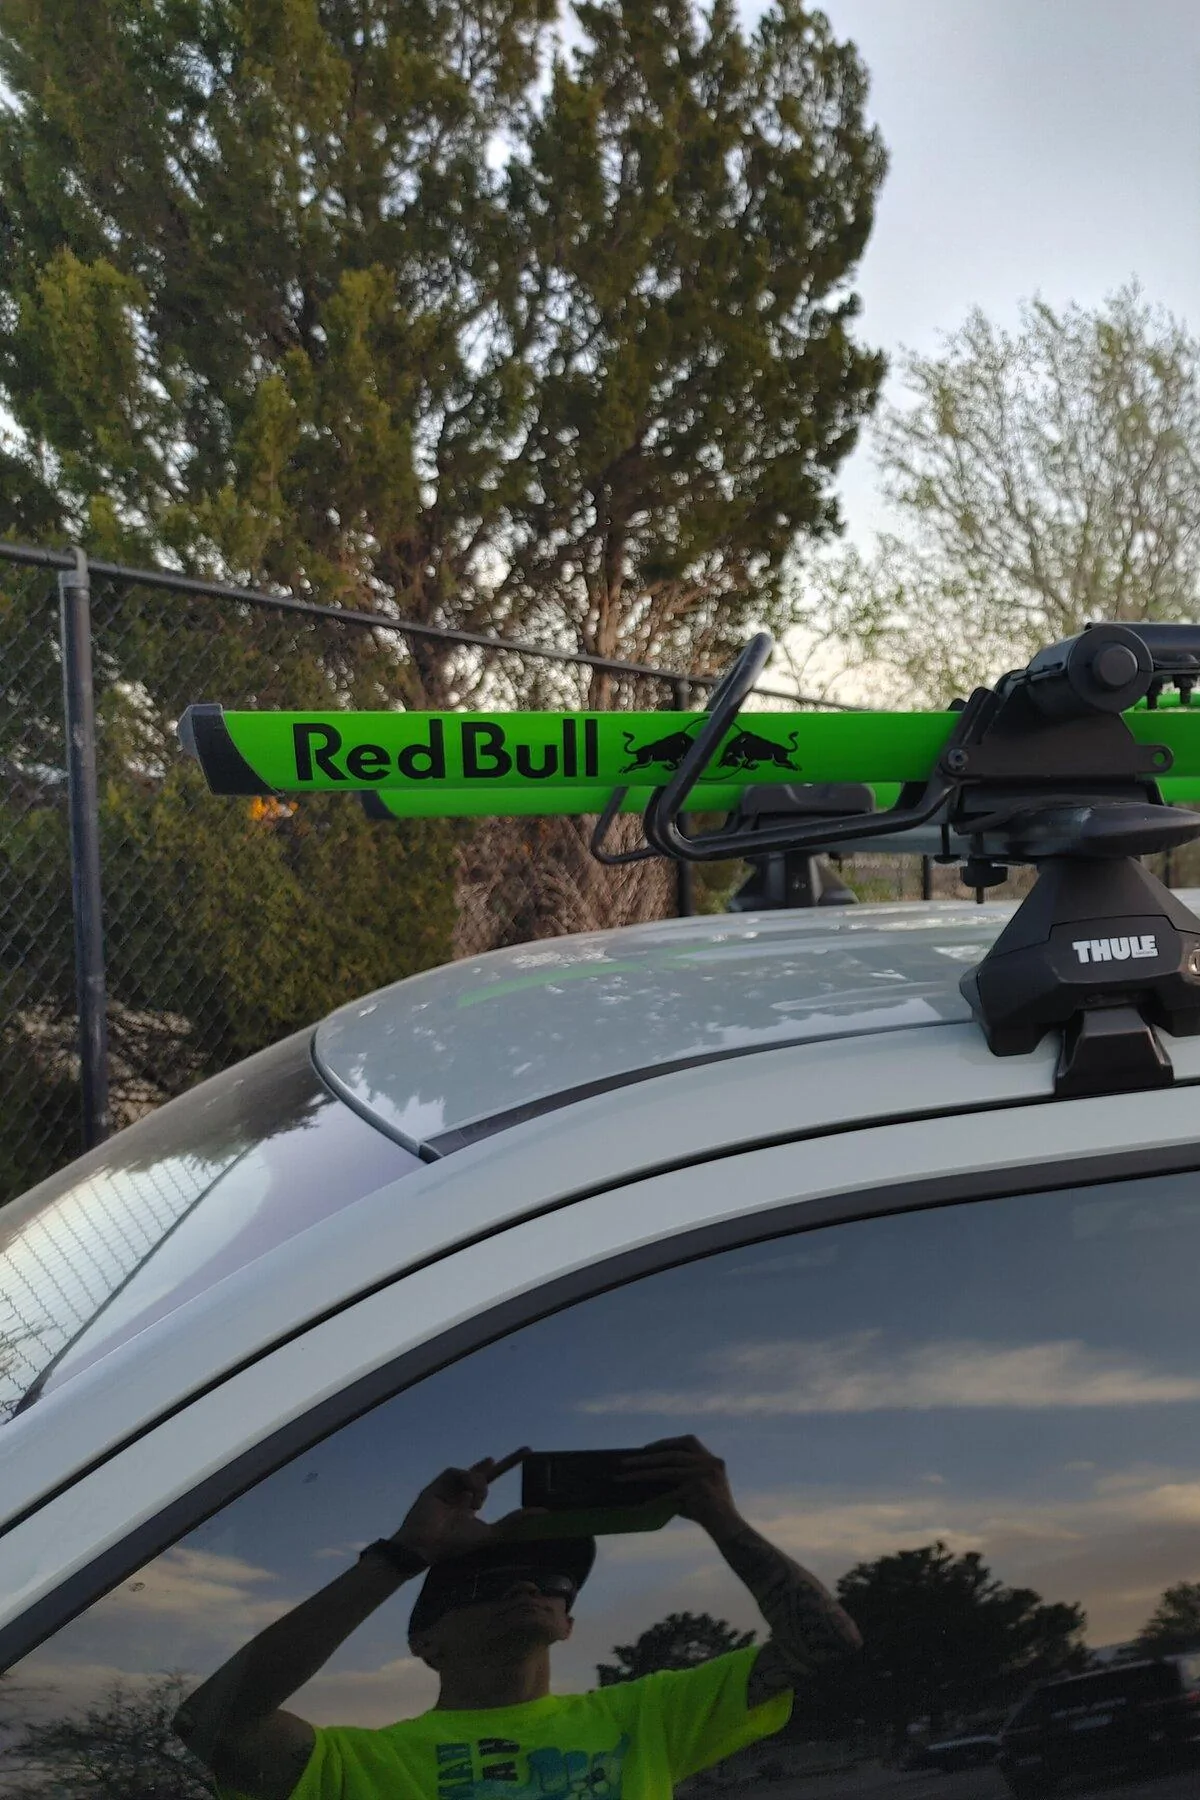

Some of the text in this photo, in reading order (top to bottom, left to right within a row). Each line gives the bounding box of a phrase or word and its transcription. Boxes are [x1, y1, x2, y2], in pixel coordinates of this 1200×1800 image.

[292, 718, 599, 782] Red Bull
[1072, 934, 1159, 964] THULE
